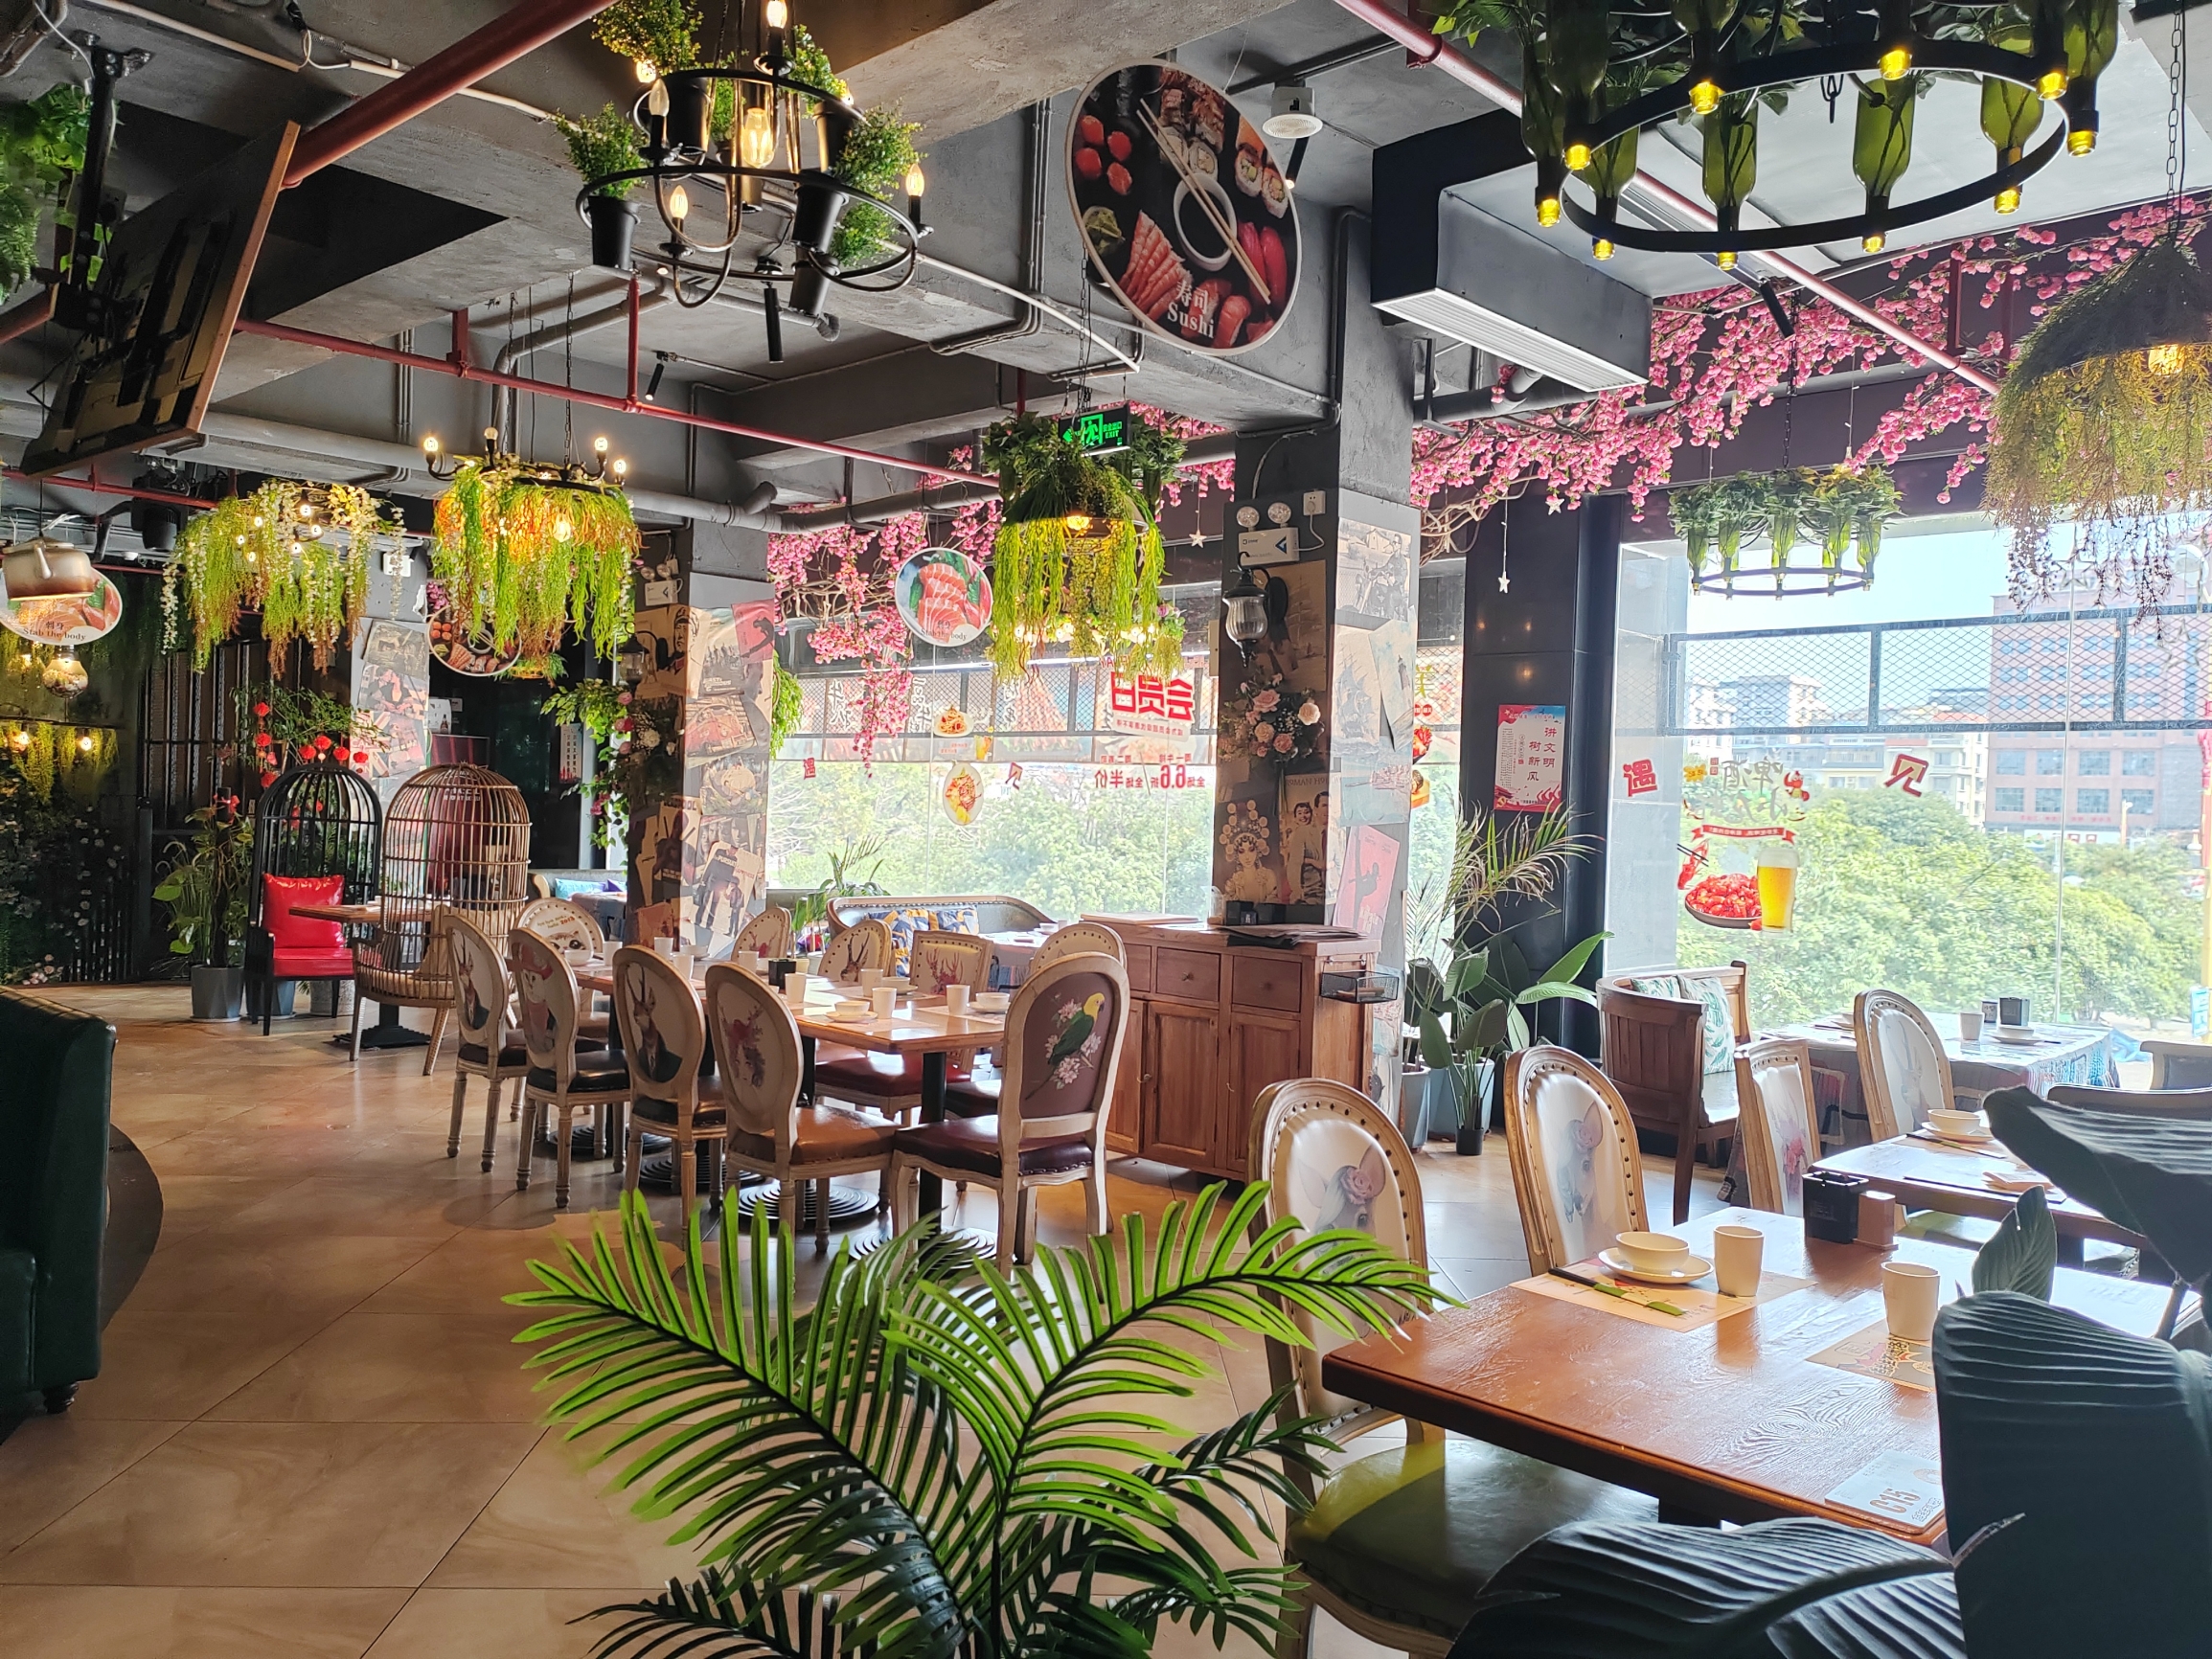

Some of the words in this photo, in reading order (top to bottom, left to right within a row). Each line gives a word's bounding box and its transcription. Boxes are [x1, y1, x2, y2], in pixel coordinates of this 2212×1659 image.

[1175, 280, 1208, 314] 寿司
[1168, 302, 1214, 338] Sushi
[1105, 430, 1119, 439] EXIT
[23, 627, 44, 637] Stab
[47, 629, 61, 638] the
[64, 631, 86, 641] body
[951, 630, 967, 641] body
[1527, 741, 1541, 782] 树新风
[1543, 728, 1557, 769] 讲文明
[1623, 758, 1659, 798] 遇
[1883, 753, 1929, 799] 见
[1869, 1487, 1922, 1513] C15
